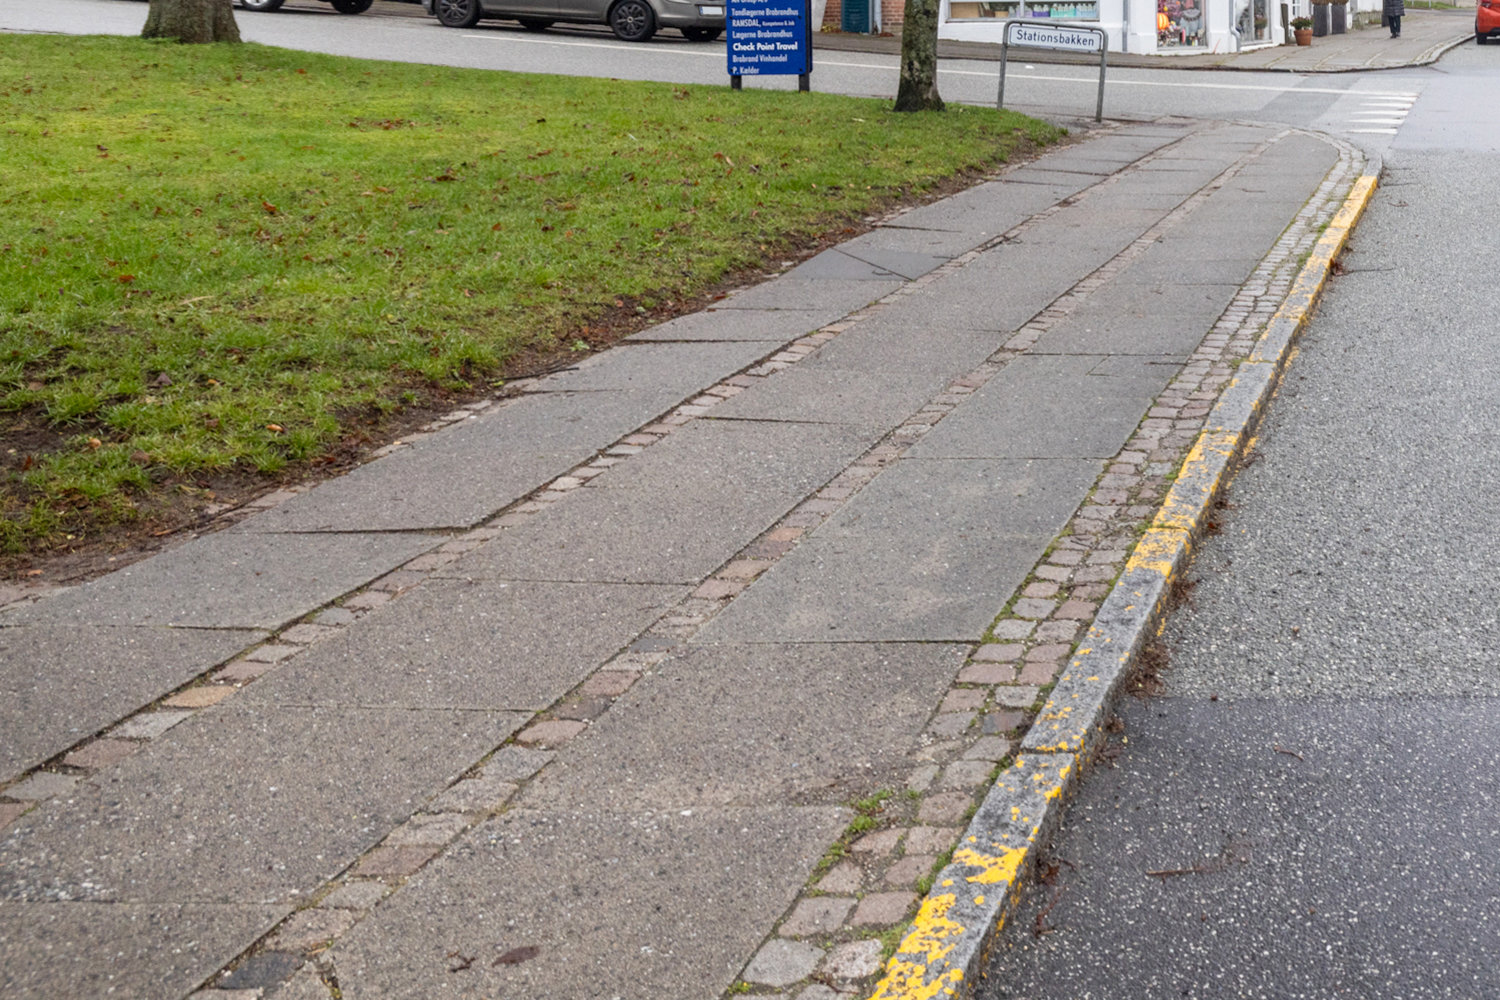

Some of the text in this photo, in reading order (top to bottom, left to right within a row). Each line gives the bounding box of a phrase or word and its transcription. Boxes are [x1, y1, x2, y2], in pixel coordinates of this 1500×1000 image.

[731, 7, 799, 18] Tandlægerne Brabrandhus
[732, 29, 793, 40] Lægerne Brabrandhus
[1016, 29, 1095, 47] Stationsbakken
[732, 41, 798, 51] Check Point Travel
[732, 54, 788, 63] Brabrand Vinhandel
[732, 66, 760, 75] P. Kælder
